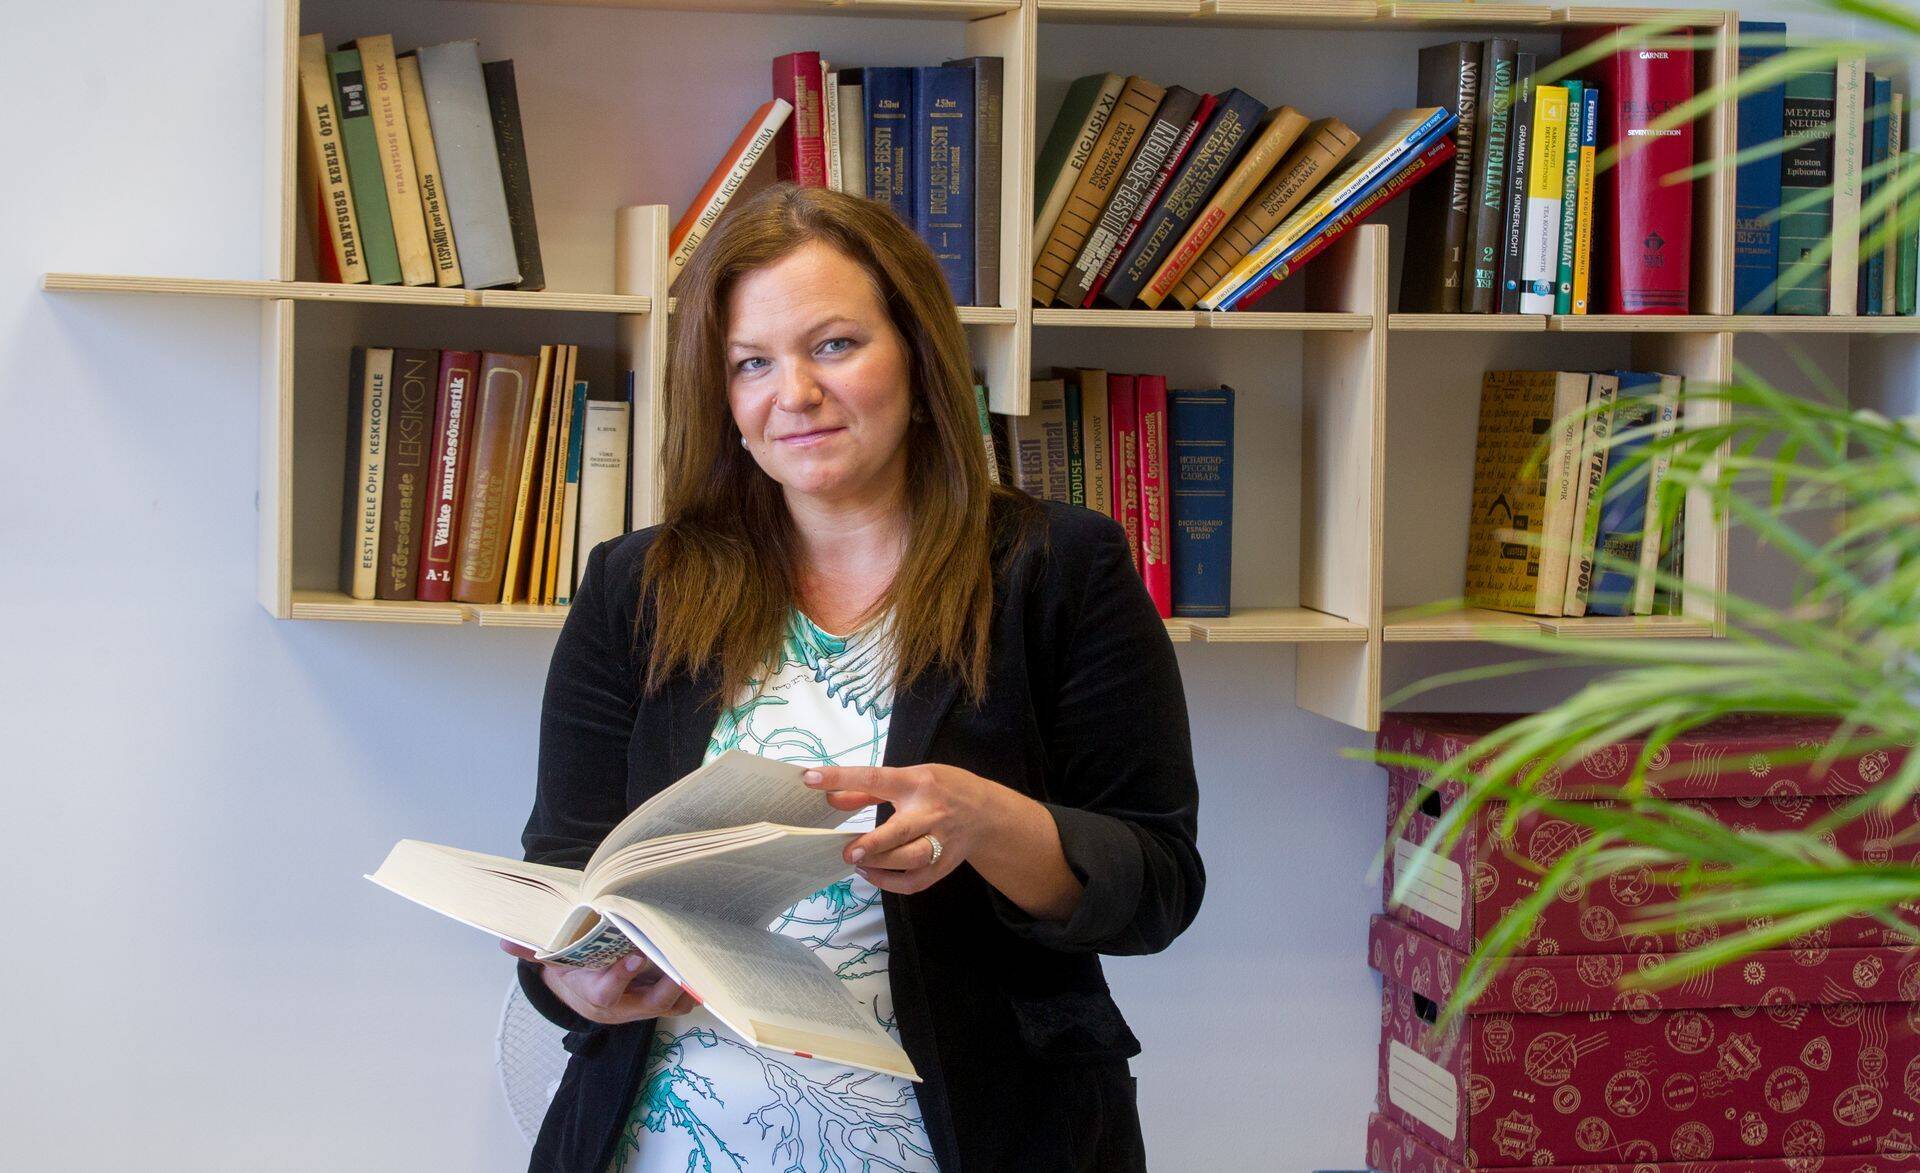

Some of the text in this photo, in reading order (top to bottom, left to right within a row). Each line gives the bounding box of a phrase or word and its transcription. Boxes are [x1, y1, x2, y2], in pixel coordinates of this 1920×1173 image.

[1639, 51, 1669, 60] GARNER
[383, 95, 396, 126] KEELE
[1549, 105, 1558, 118] 4
[1567, 102, 1579, 153] EESTI-SAKSA
[1784, 107, 1831, 119] MEYERS
[1071, 92, 1115, 170] ENGLISH XI
[1845, 142, 1855, 154] der
[324, 142, 342, 185] KEELE
[388, 133, 406, 194] PRANTSUSE
[1088, 120, 1127, 186] INGLISE-EESTI
[1164, 108, 1238, 213] EESTI-INGLISE
[1794, 158, 1821, 167] Boston
[1099, 118, 1180, 235] INGLISE-EESTI
[1259, 153, 1312, 211] INGLISE-EESTI
[1386, 157, 1425, 190] Essential
[1510, 124, 1528, 257] GRAMMATIK IST KINDERLEICHT!
[1350, 187, 1388, 218] Grammar
[333, 190, 358, 266] PRANTSUSE
[435, 211, 447, 230] por
[1324, 221, 1343, 238] Use
[433, 226, 451, 260] ESPAÑOL
[1134, 216, 1174, 270] SILVET
[1153, 245, 1195, 295] INGLISE
[1189, 206, 1224, 249] KEELE
[1482, 246, 1494, 263] 2
[369, 373, 384, 455] KESKKOOLILE
[397, 358, 427, 468] LEKSIKON
[1070, 459, 1083, 506] EADUSE
[365, 497, 377, 531] KEELE
[433, 504, 452, 548] Väike
[1141, 485, 1161, 564] Vene-eesti
[363, 533, 376, 568] EESTI
[426, 569, 451, 582] A-L
[1865, 761, 1878, 774] 37
[1859, 967, 1873, 981] 37
[1747, 1126, 1761, 1138] 37
